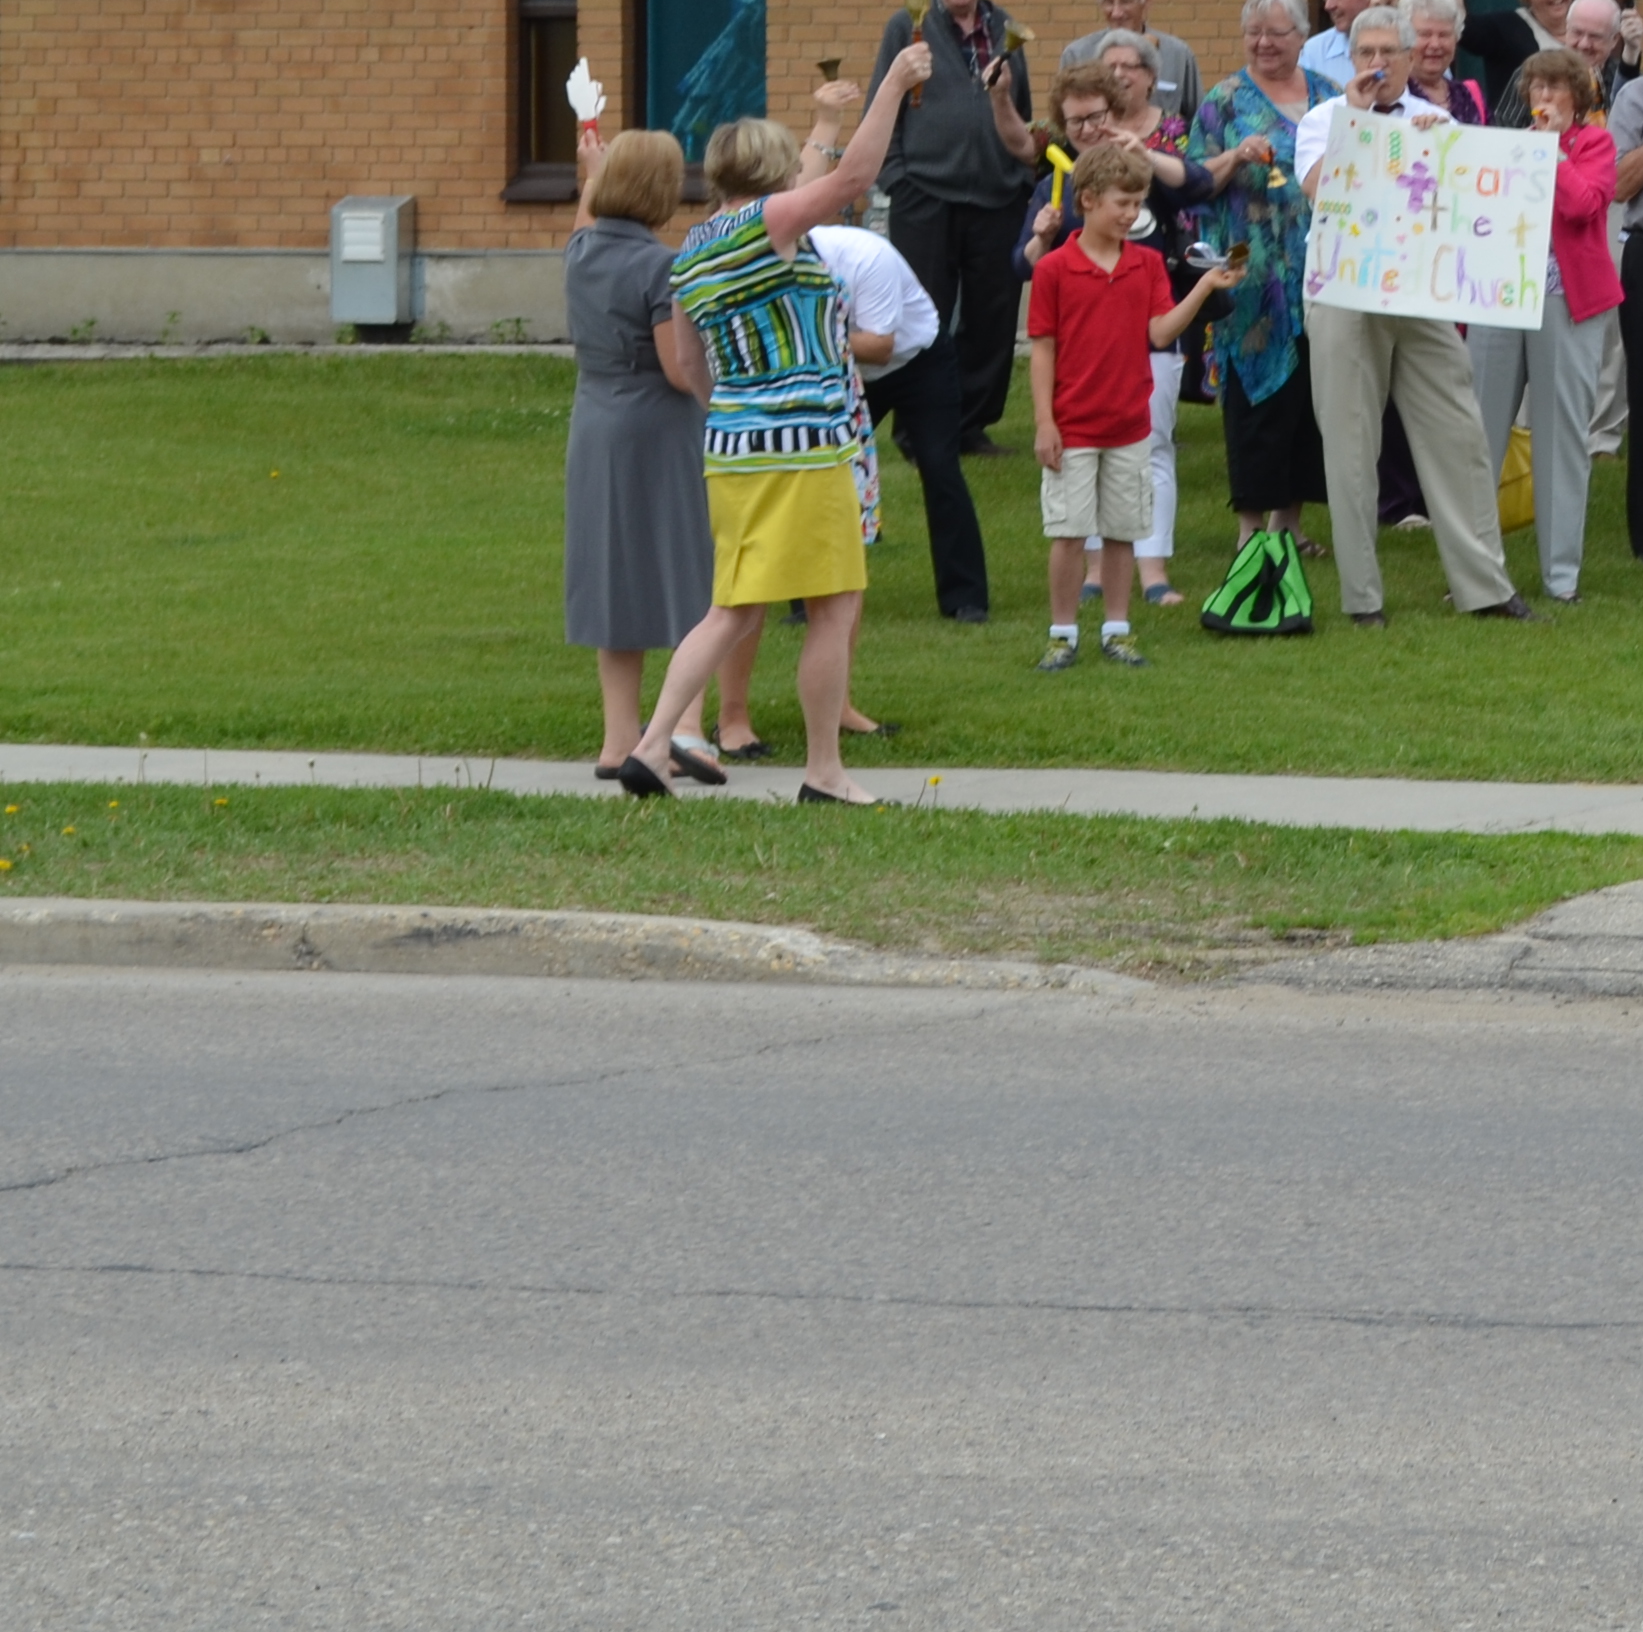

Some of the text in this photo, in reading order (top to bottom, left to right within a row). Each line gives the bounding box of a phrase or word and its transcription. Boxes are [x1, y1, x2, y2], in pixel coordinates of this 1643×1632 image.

[1355, 123, 1550, 204] 90 Years
[1423, 189, 1493, 238] the
[1316, 231, 1540, 313] United Church
